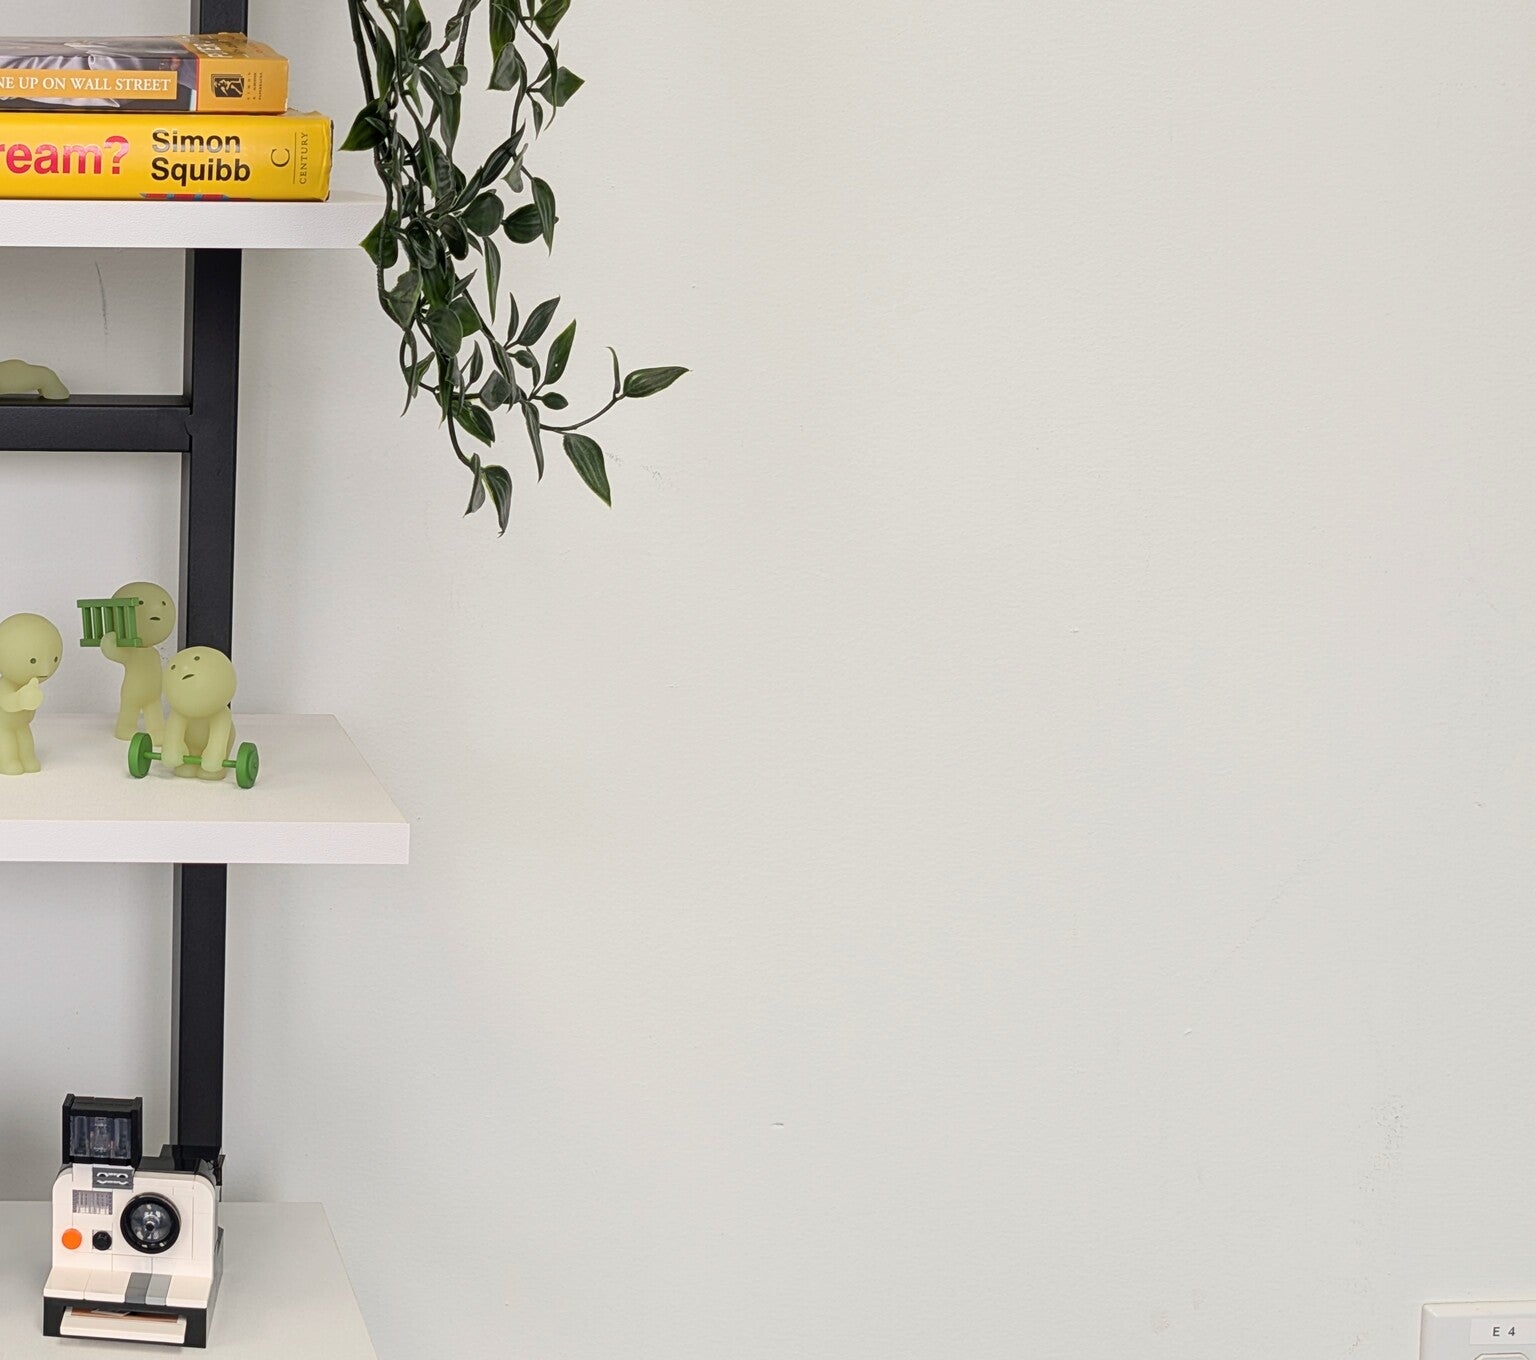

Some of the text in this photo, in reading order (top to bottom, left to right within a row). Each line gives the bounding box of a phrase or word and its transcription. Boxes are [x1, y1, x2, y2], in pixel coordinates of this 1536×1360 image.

[19, 76, 38, 90] UP
[42, 77, 67, 90] ON
[69, 77, 112, 91] WALL
[115, 78, 172, 92] STREET
[151, 129, 241, 154] Simon
[299, 131, 309, 185] CENTURY
[151, 157, 251, 187] Squibb
[1492, 1326, 1516, 1336] E 4
